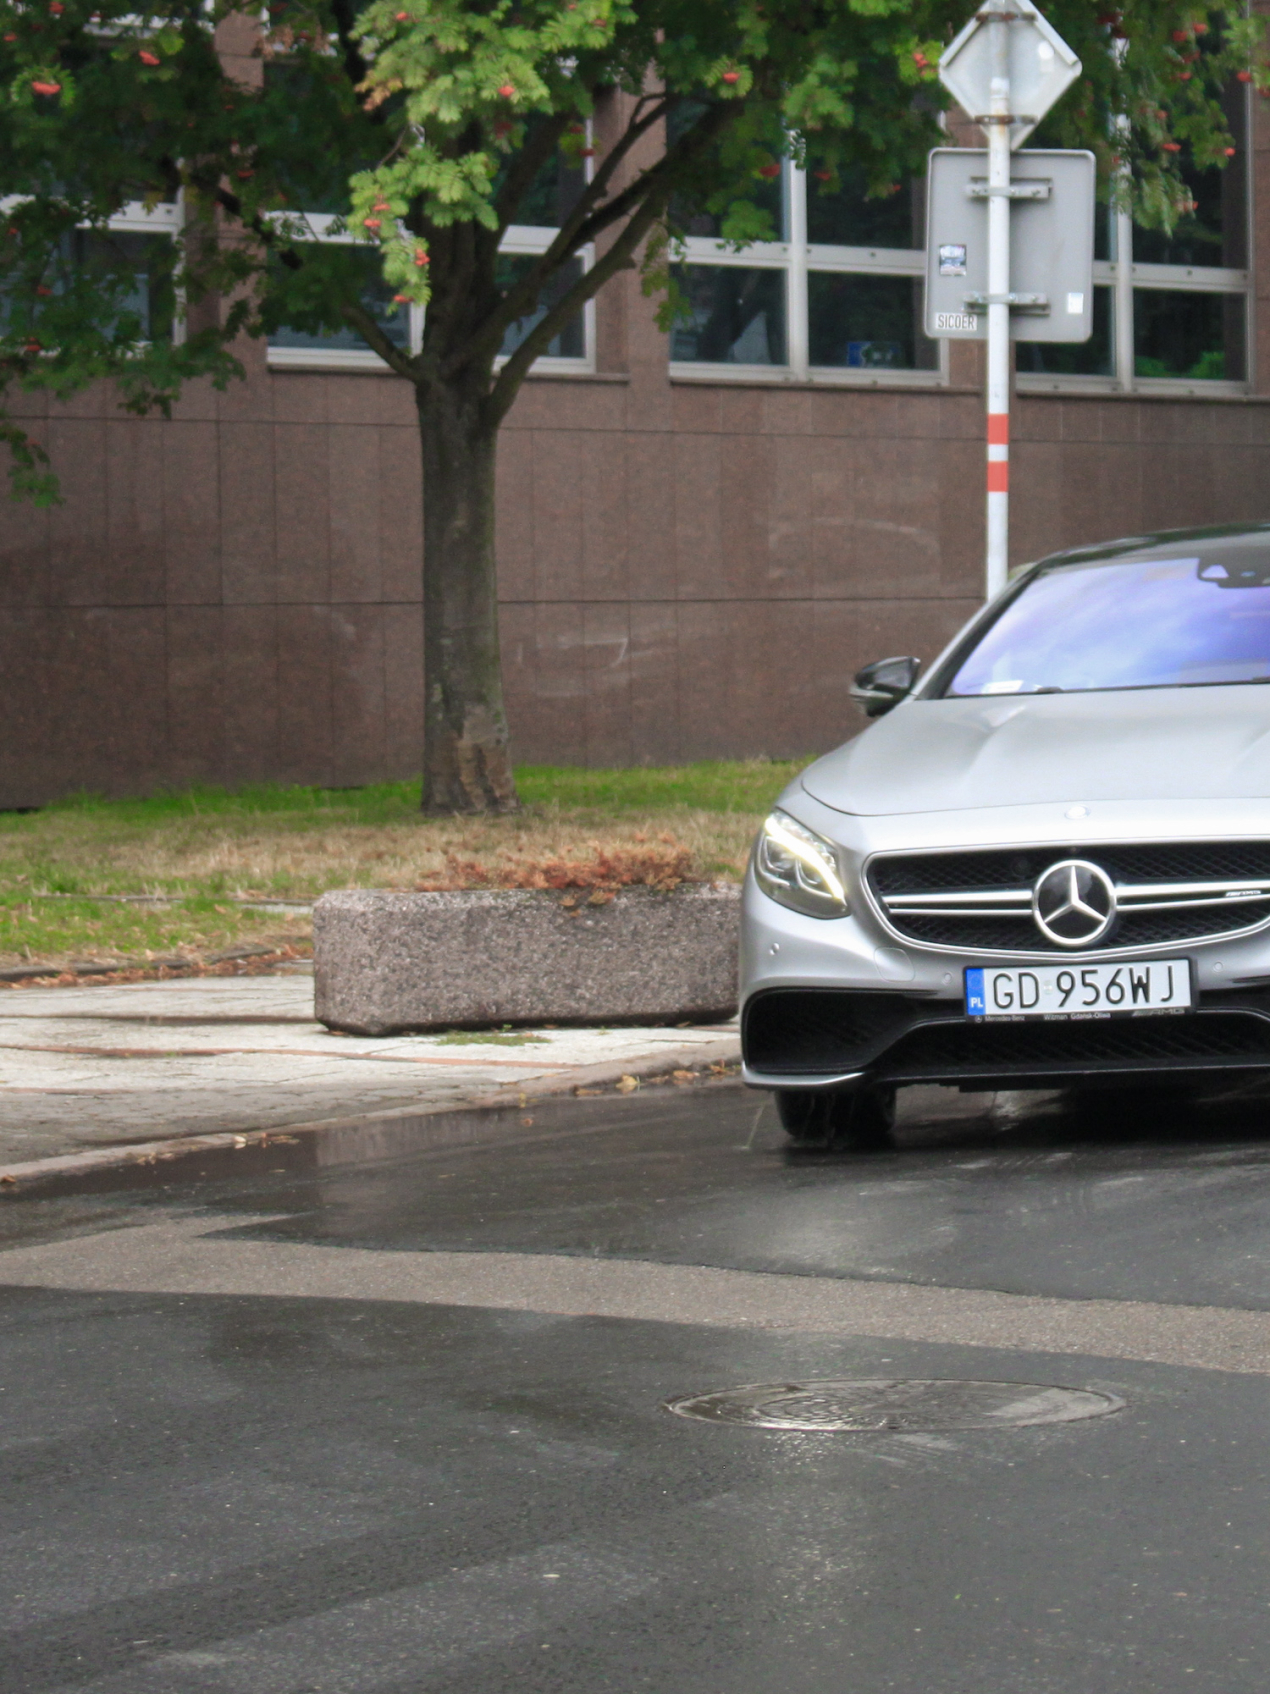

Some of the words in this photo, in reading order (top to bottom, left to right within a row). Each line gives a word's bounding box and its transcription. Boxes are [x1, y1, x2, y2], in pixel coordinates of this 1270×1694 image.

[937, 314, 975, 329] SICOER
[993, 971, 1040, 1009] GD
[1056, 964, 1174, 1008] 956WJ
[970, 997, 984, 1008] PL
